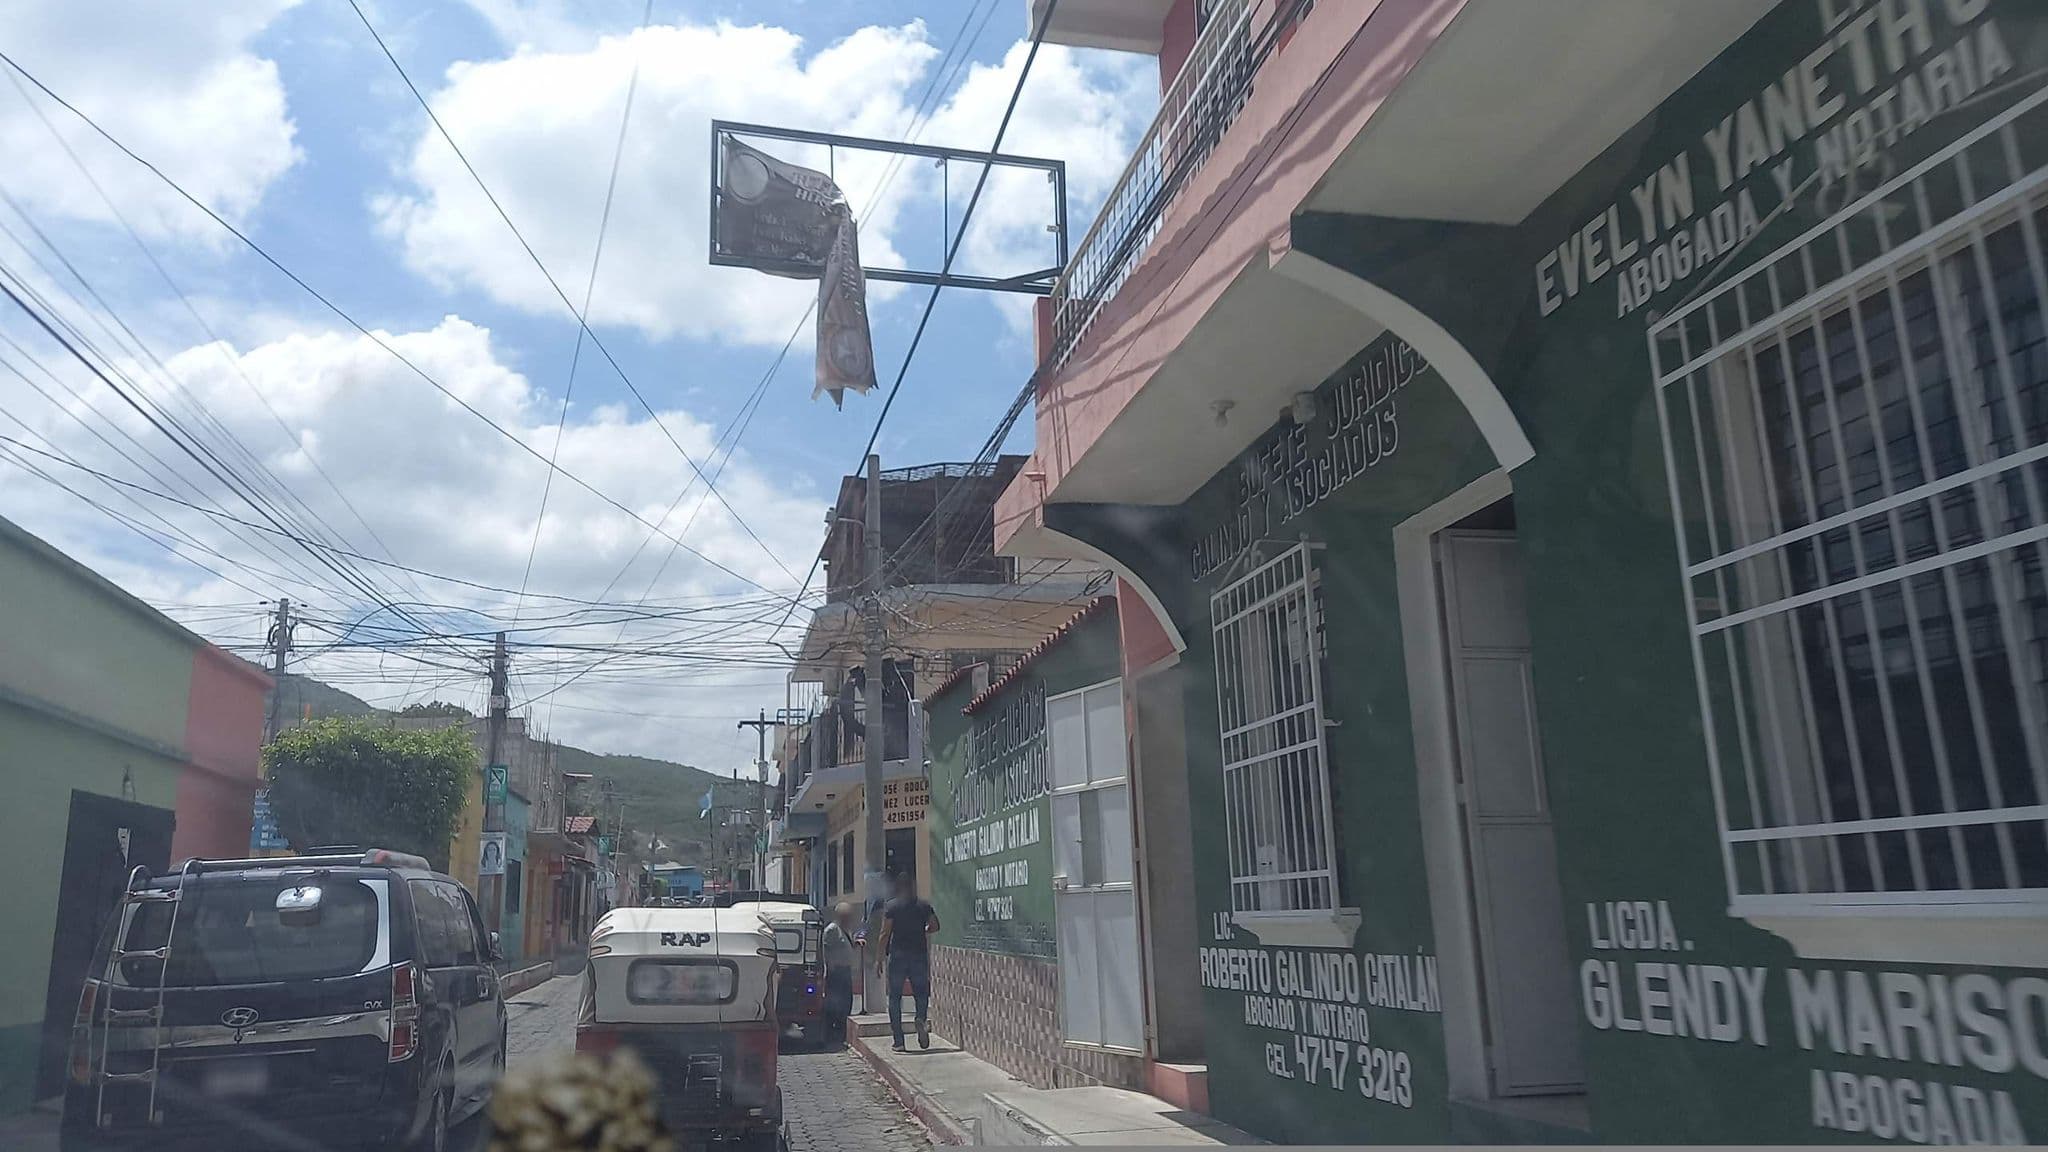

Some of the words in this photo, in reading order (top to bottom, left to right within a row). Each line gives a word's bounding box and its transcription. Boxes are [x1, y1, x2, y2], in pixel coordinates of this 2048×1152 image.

[1535, 150, 1694, 318] EVELYN
[1703, 0, 1932, 191] YANETH
[1616, 187, 1762, 319] ABOGADA
[1770, 156, 1796, 213] Y
[1815, 17, 2015, 187] NOTARIA
[1281, 400, 1399, 526] ASOCIADOS
[660, 932, 711, 948] RAP
[1213, 912, 1236, 941] LIC.
[1587, 900, 1695, 951] LICDA.
[1200, 947, 1271, 993] ROBERTO
[1275, 950, 1360, 1004] GALINDO
[1364, 945, 1442, 1012] CATALÁN
[1245, 995, 1296, 1031] ABOGADO
[1299, 1000, 1308, 1034] Y
[1311, 1003, 1370, 1044] NOTARIO
[1580, 958, 1769, 1047] GLENDY
[1786, 968, 2048, 1080] MARISO
[1265, 1042, 1295, 1079] CEL.
[1294, 1034, 1350, 1091] 4747
[1356, 1044, 1413, 1109] 3213
[1811, 1068, 2030, 1146] ABOGADA
